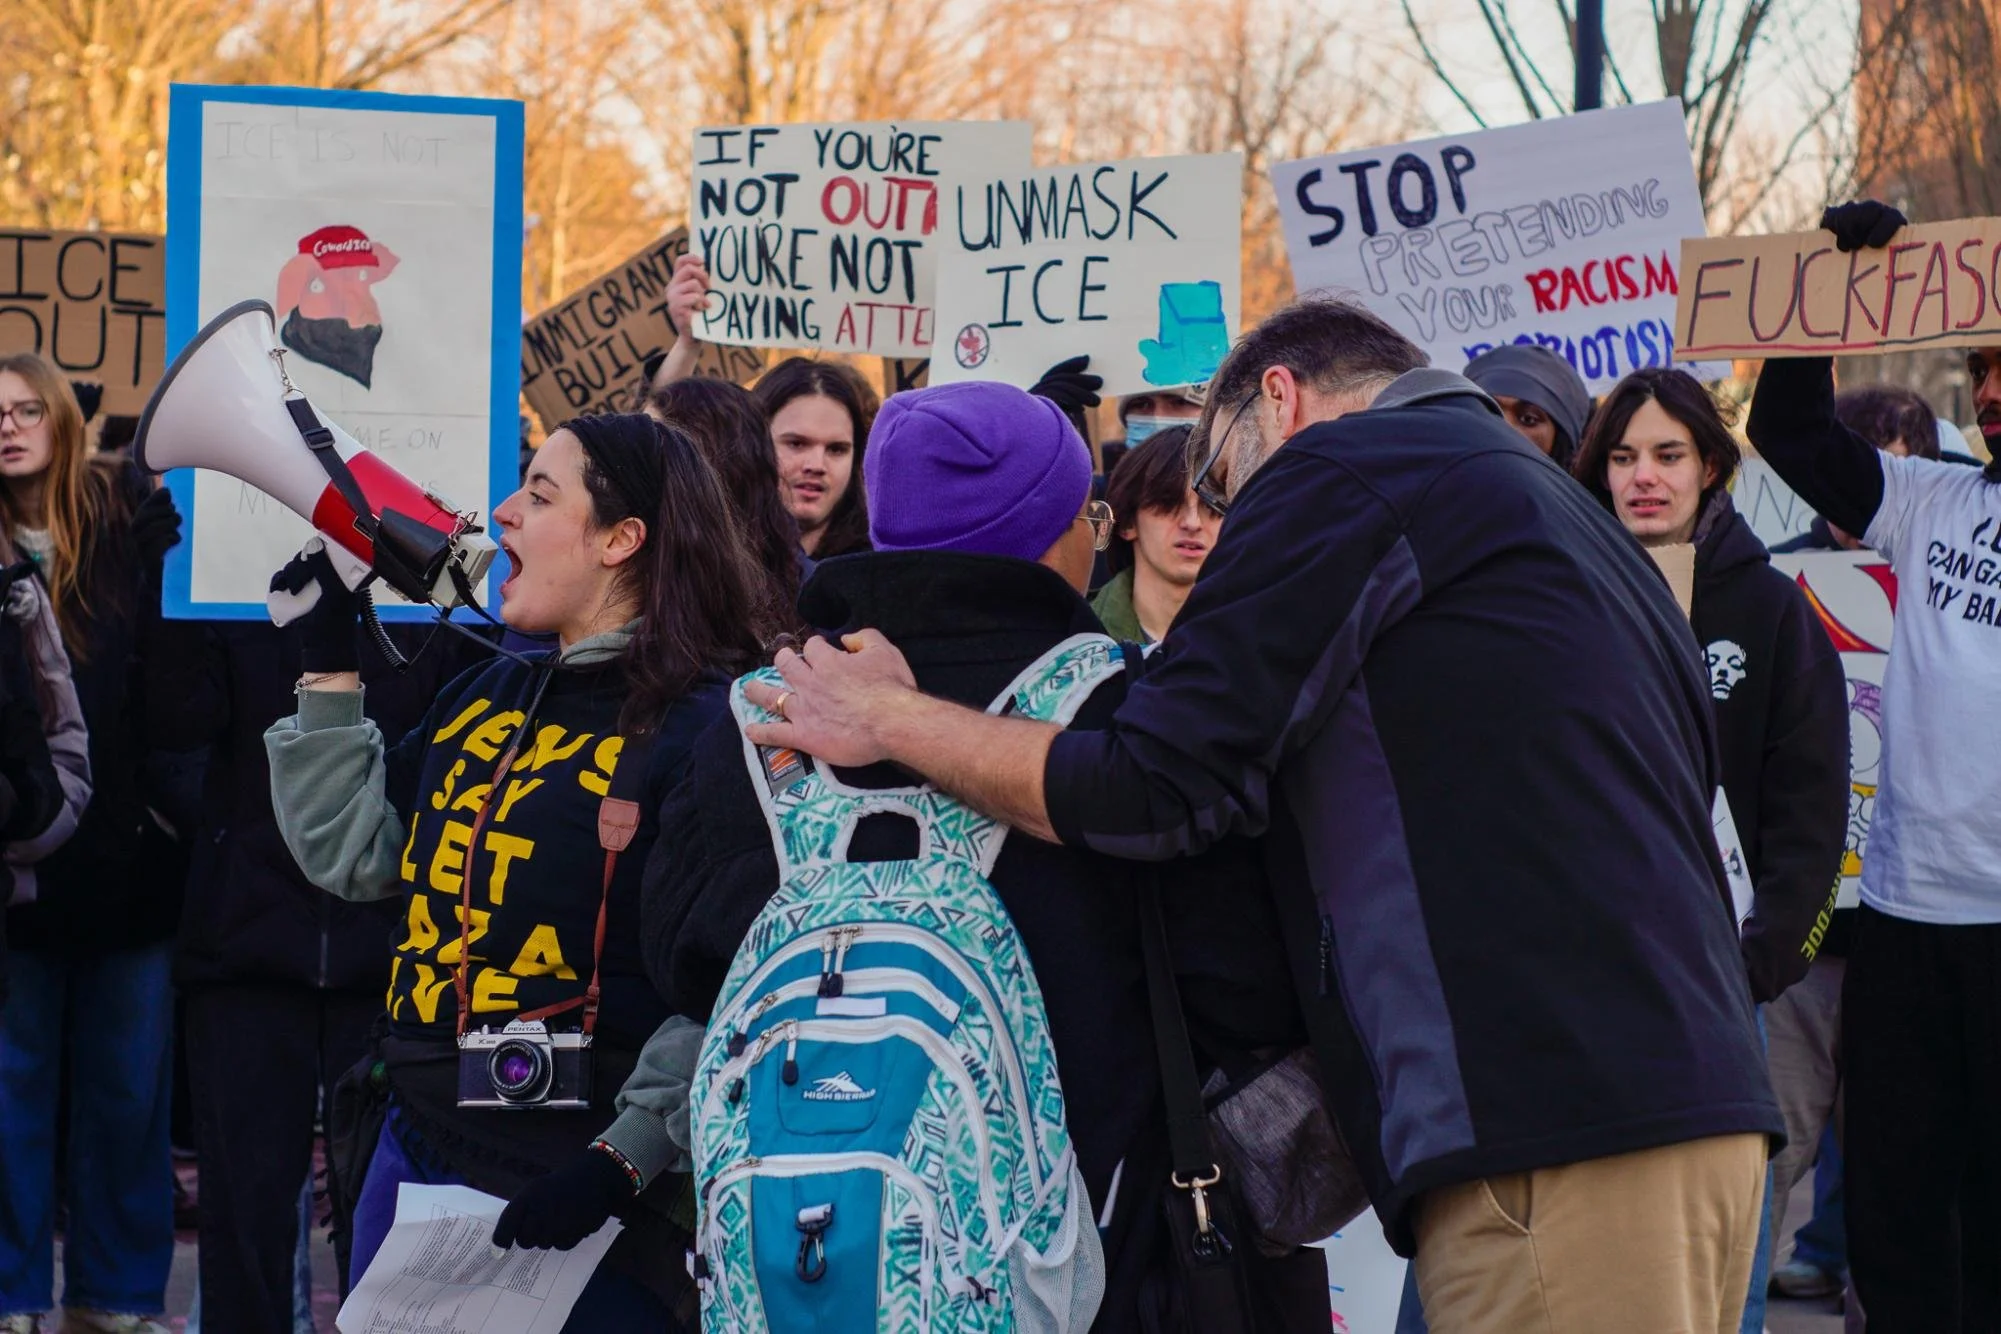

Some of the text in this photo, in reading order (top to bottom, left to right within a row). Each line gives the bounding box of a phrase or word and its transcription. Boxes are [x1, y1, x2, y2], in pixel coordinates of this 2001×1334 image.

[215, 121, 448, 169] ICE IS NOT
[699, 124, 943, 176] IF YOU'RE
[701, 173, 799, 220] NOT
[957, 166, 1179, 251] UNMASK
[1296, 144, 1476, 248] STOP
[0, 233, 155, 307] ICE
[830, 233, 924, 304] NOT
[1358, 178, 1670, 296] PRETENDING
[703, 289, 936, 350] PAYING ATTE
[986, 255, 1109, 328] ICE
[1396, 250, 1679, 344] YOUR RACISM
[0, 301, 165, 388] OUT
[407, 428, 444, 451] ON
[1926, 540, 1974, 580] CAN
[1926, 576, 1963, 611] MY
[431, 758, 545, 822] SAY
[400, 811, 535, 906] LET
[803, 1090, 833, 1100] HIGH
